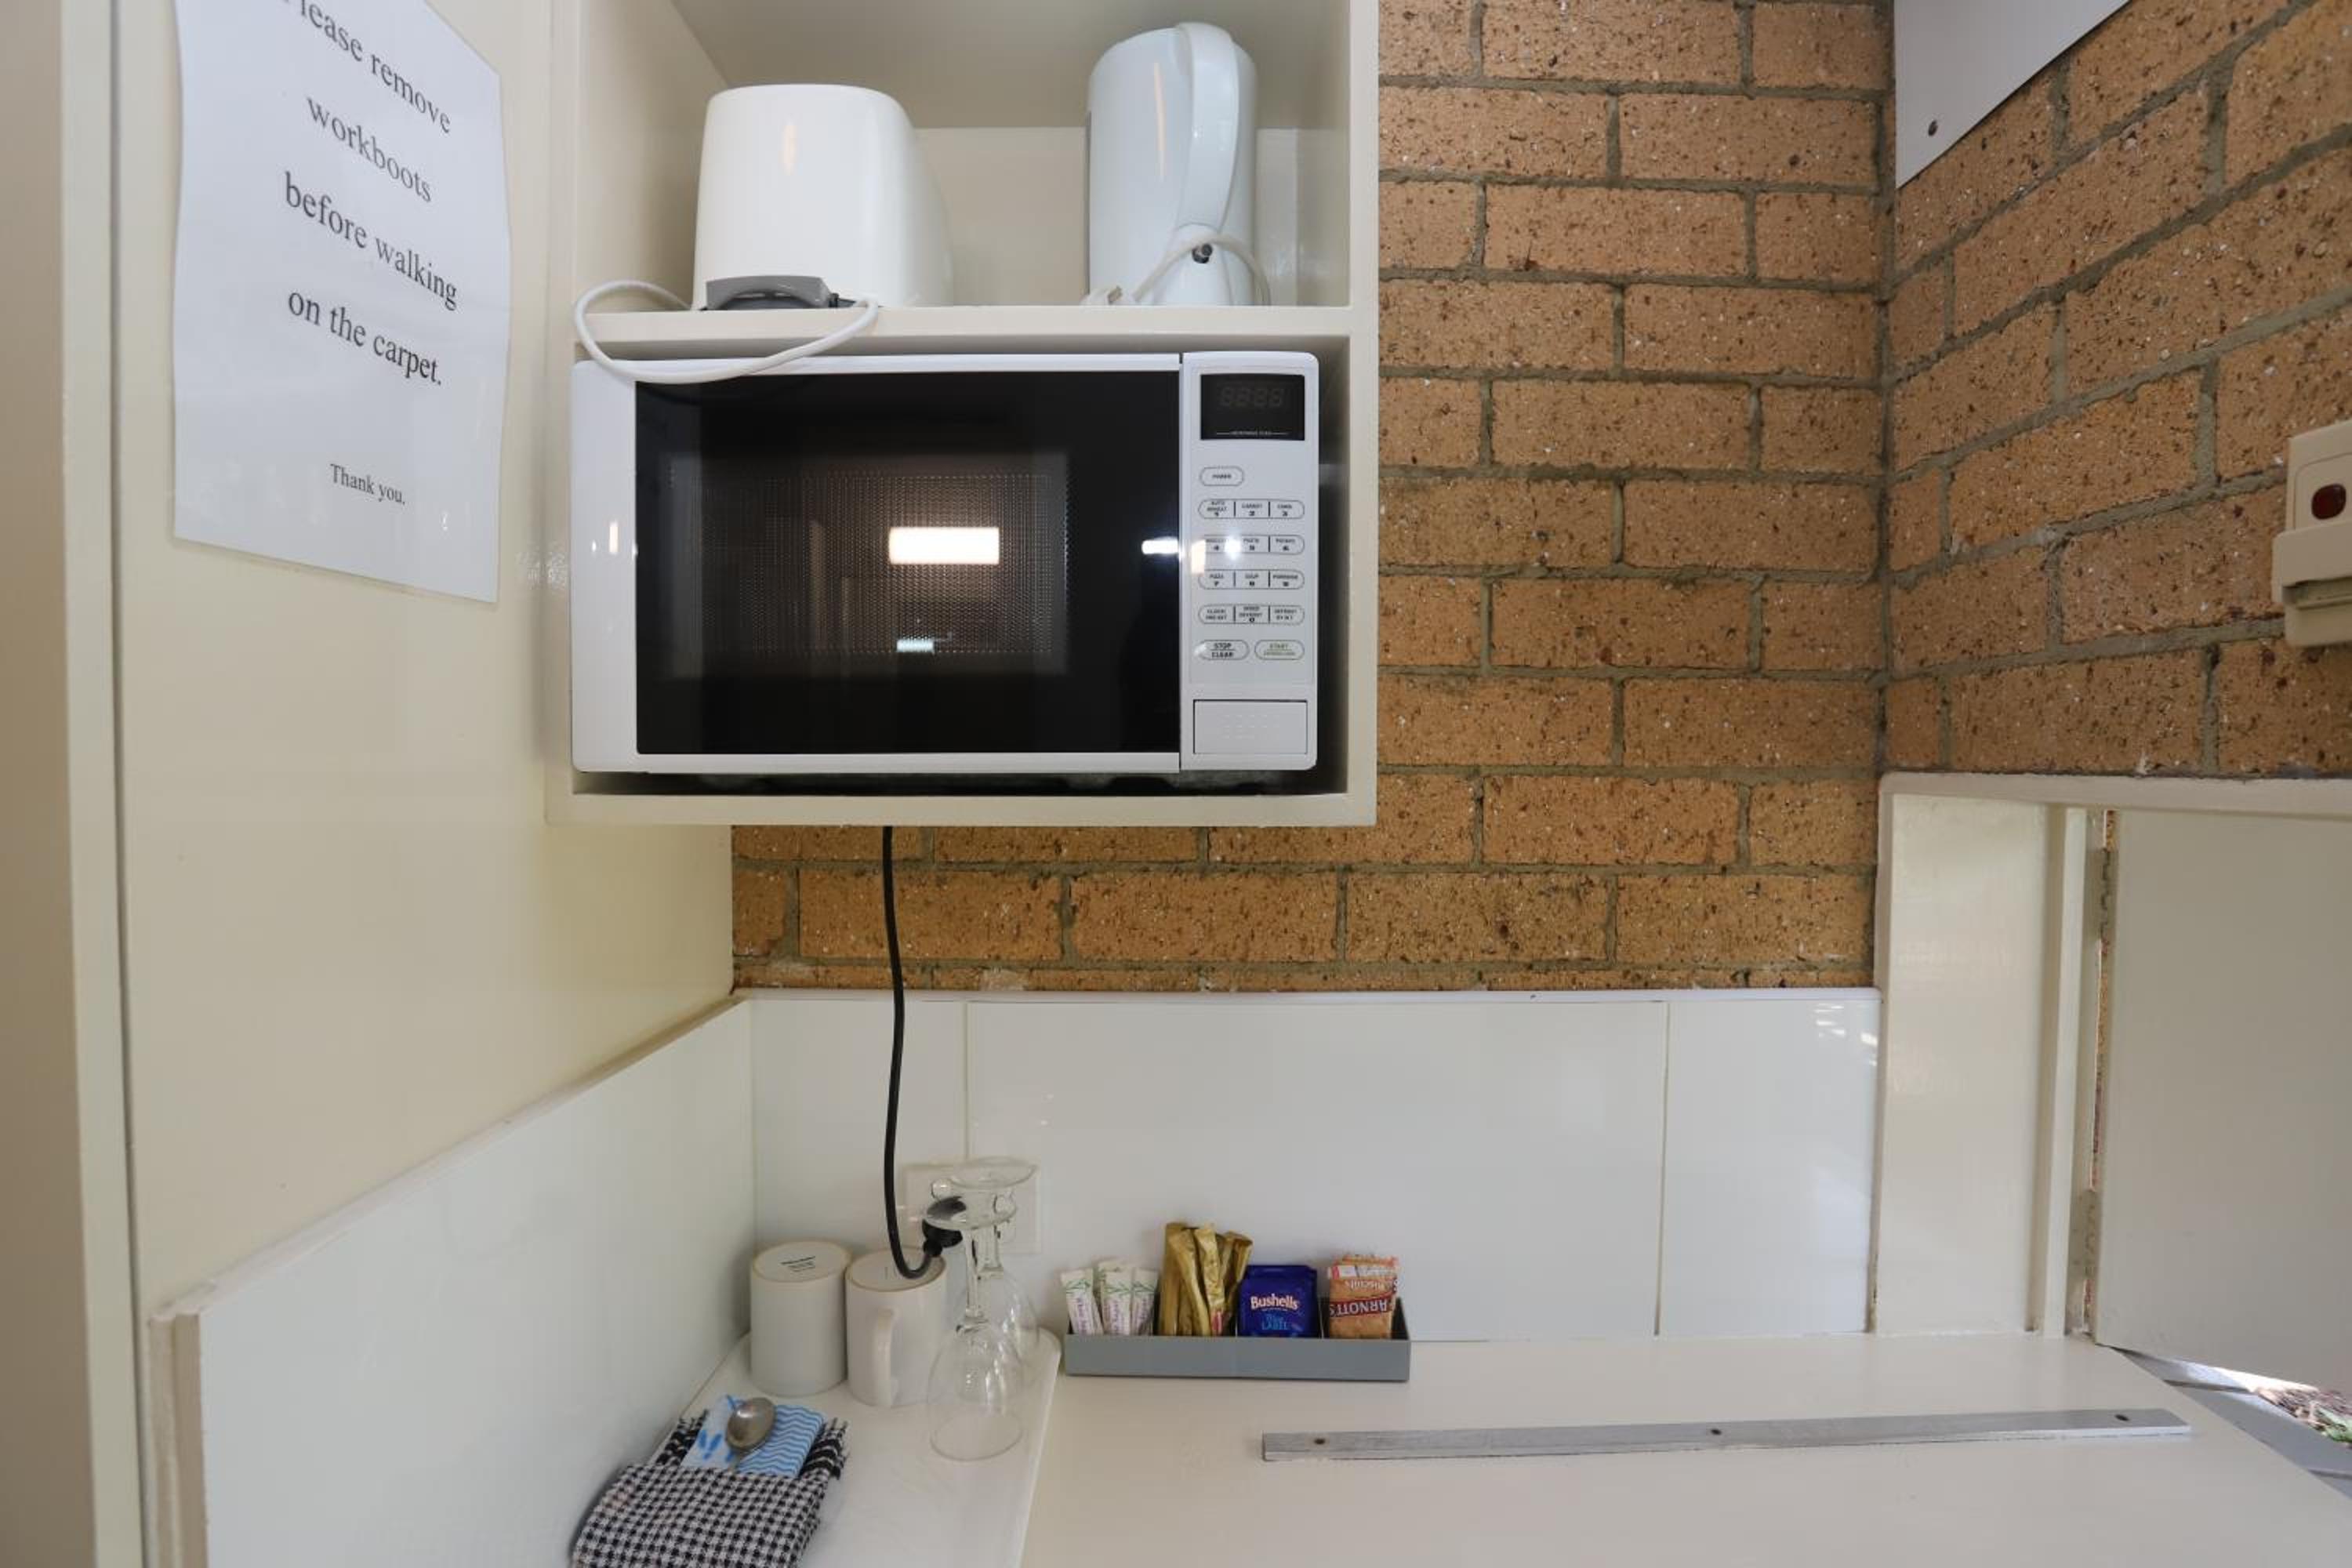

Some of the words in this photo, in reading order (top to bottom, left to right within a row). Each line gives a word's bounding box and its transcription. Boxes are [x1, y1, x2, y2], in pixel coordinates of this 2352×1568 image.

[274, 0, 363, 62] lease
[370, 53, 451, 133] remove
[307, 96, 431, 203] workboots
[285, 170, 368, 249] before
[375, 237, 457, 311] walking
[289, 292, 321, 326] on
[330, 307, 366, 347] the
[373, 335, 441, 386] carpet.
[330, 463, 374, 495] Thank
[378, 484, 405, 506] you.
[1250, 1292, 1299, 1311] Bushells
